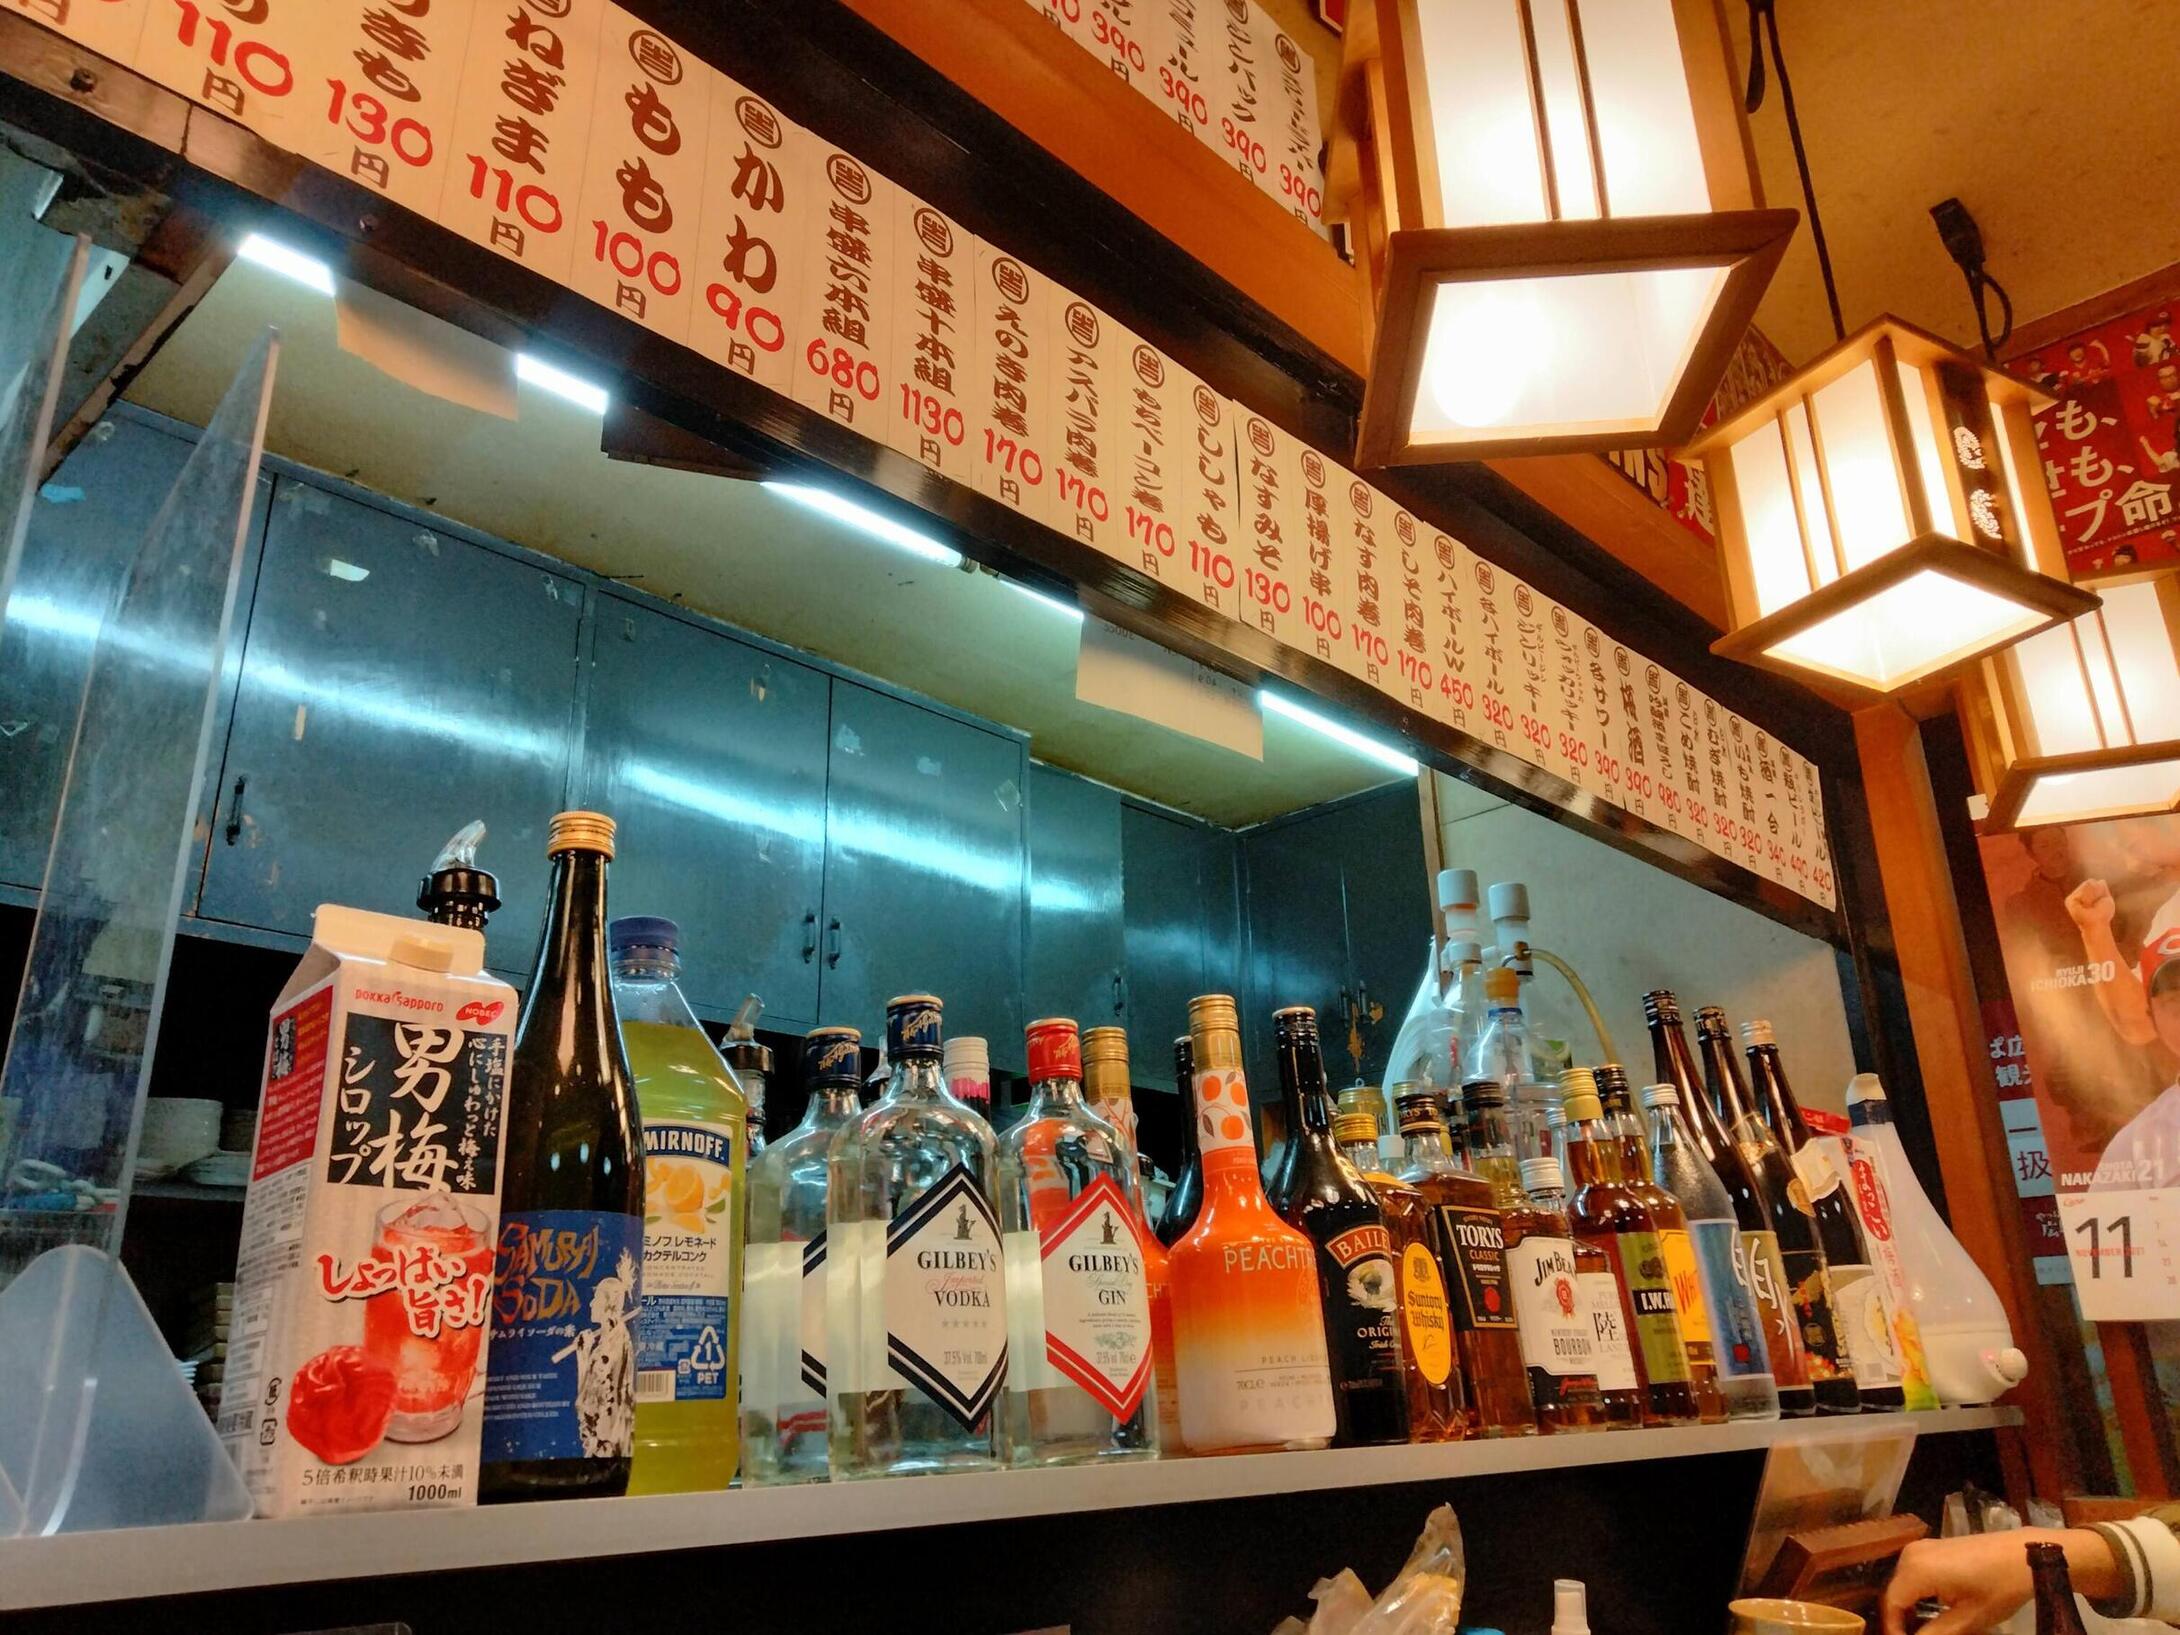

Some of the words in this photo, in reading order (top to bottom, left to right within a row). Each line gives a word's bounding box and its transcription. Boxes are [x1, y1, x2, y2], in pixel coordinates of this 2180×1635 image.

[174, 0, 294, 97] 110
[1091, 11, 1145, 72] 390
[202, 67, 245, 116] 円
[491, 5, 567, 176] ねぎま
[1159, 66, 1208, 125] 390
[326, 78, 434, 168] 130
[350, 145, 390, 190] 円
[616, 81, 682, 234] もも
[1221, 117, 1267, 174] 390
[466, 153, 563, 234] 110
[1280, 164, 1321, 218] 390
[490, 216, 525, 258] 円
[723, 141, 785, 294] かわ
[592, 220, 682, 296] 100
[615, 279, 647, 319] 円
[706, 282, 785, 352] 90
[913, 253, 957, 397] 串盛十本組
[728, 337, 756, 375] 円
[806, 338, 880, 401] 680
[991, 303, 1029, 437] えのき肉巻
[830, 388, 853, 425] 円
[901, 383, 965, 447] 1130
[919, 433, 941, 468] 円
[984, 428, 1043, 486] 170
[1000, 475, 1020, 506] 円
[1056, 467, 1109, 522] 170
[1197, 425, 1228, 546] ししゃも
[1075, 512, 1095, 543] 円
[1125, 505, 1176, 557] 170
[1250, 454, 1283, 572] なすみそ
[1304, 486, 1331, 597] 厚揚げ串
[1142, 549, 1161, 580] 円
[1188, 540, 1235, 588] 110
[1352, 517, 1381, 628] なす肉巻
[1204, 579, 1219, 608] 円
[1245, 567, 1291, 614] 130
[1401, 549, 1427, 654] しそ肉巻
[1260, 608, 1275, 634] 円
[1302, 595, 1342, 640] 100
[1437, 571, 1465, 673] ハイボールW
[1316, 636, 1331, 660] 円
[1351, 623, 1389, 667] 170
[1479, 596, 1505, 696] 各ハイボール
[1366, 661, 1380, 685] 円
[1397, 649, 1432, 690] 170
[1440, 672, 1474, 710] 450
[1410, 686, 1423, 708] 円
[1452, 706, 1466, 729] 円
[1482, 693, 1514, 732] 320
[1589, 660, 1610, 750] 各サワー
[1494, 728, 1508, 750] 円
[1520, 713, 1552, 750] 320
[1559, 731, 1589, 768] 320
[1594, 749, 1621, 785] 390
[1625, 766, 1652, 799] 390
[1658, 781, 1683, 815] 980
[1686, 797, 1709, 829] 320
[1713, 811, 1738, 842] 320
[1740, 824, 1764, 856] 320
[2087, 961, 2116, 985] 30
[368, 1021, 466, 1193] 男梅
[482, 1037, 505, 1137] 手塩にかけた
[331, 1046, 376, 1184] シロップ
[1456, 1224, 1504, 1249] TORYS
[1469, 1249, 1500, 1261] CLASSIC
[2075, 1215, 2133, 1279] 11
[317, 1246, 463, 1296] しょっぱい
[917, 1249, 997, 1272] GILBEY'S
[1068, 1252, 1139, 1275] GILBEY'S
[494, 1276, 581, 1324] SODA
[934, 1290, 991, 1308] VODKA
[1098, 1289, 1126, 1306] GIN
[1408, 1291, 1443, 1312] Suntory
[1411, 1311, 1445, 1331] Whisky
[1553, 1338, 1592, 1356] BOURBON
[697, 1371, 719, 1385] PET
[408, 1484, 462, 1501] 1000ml
